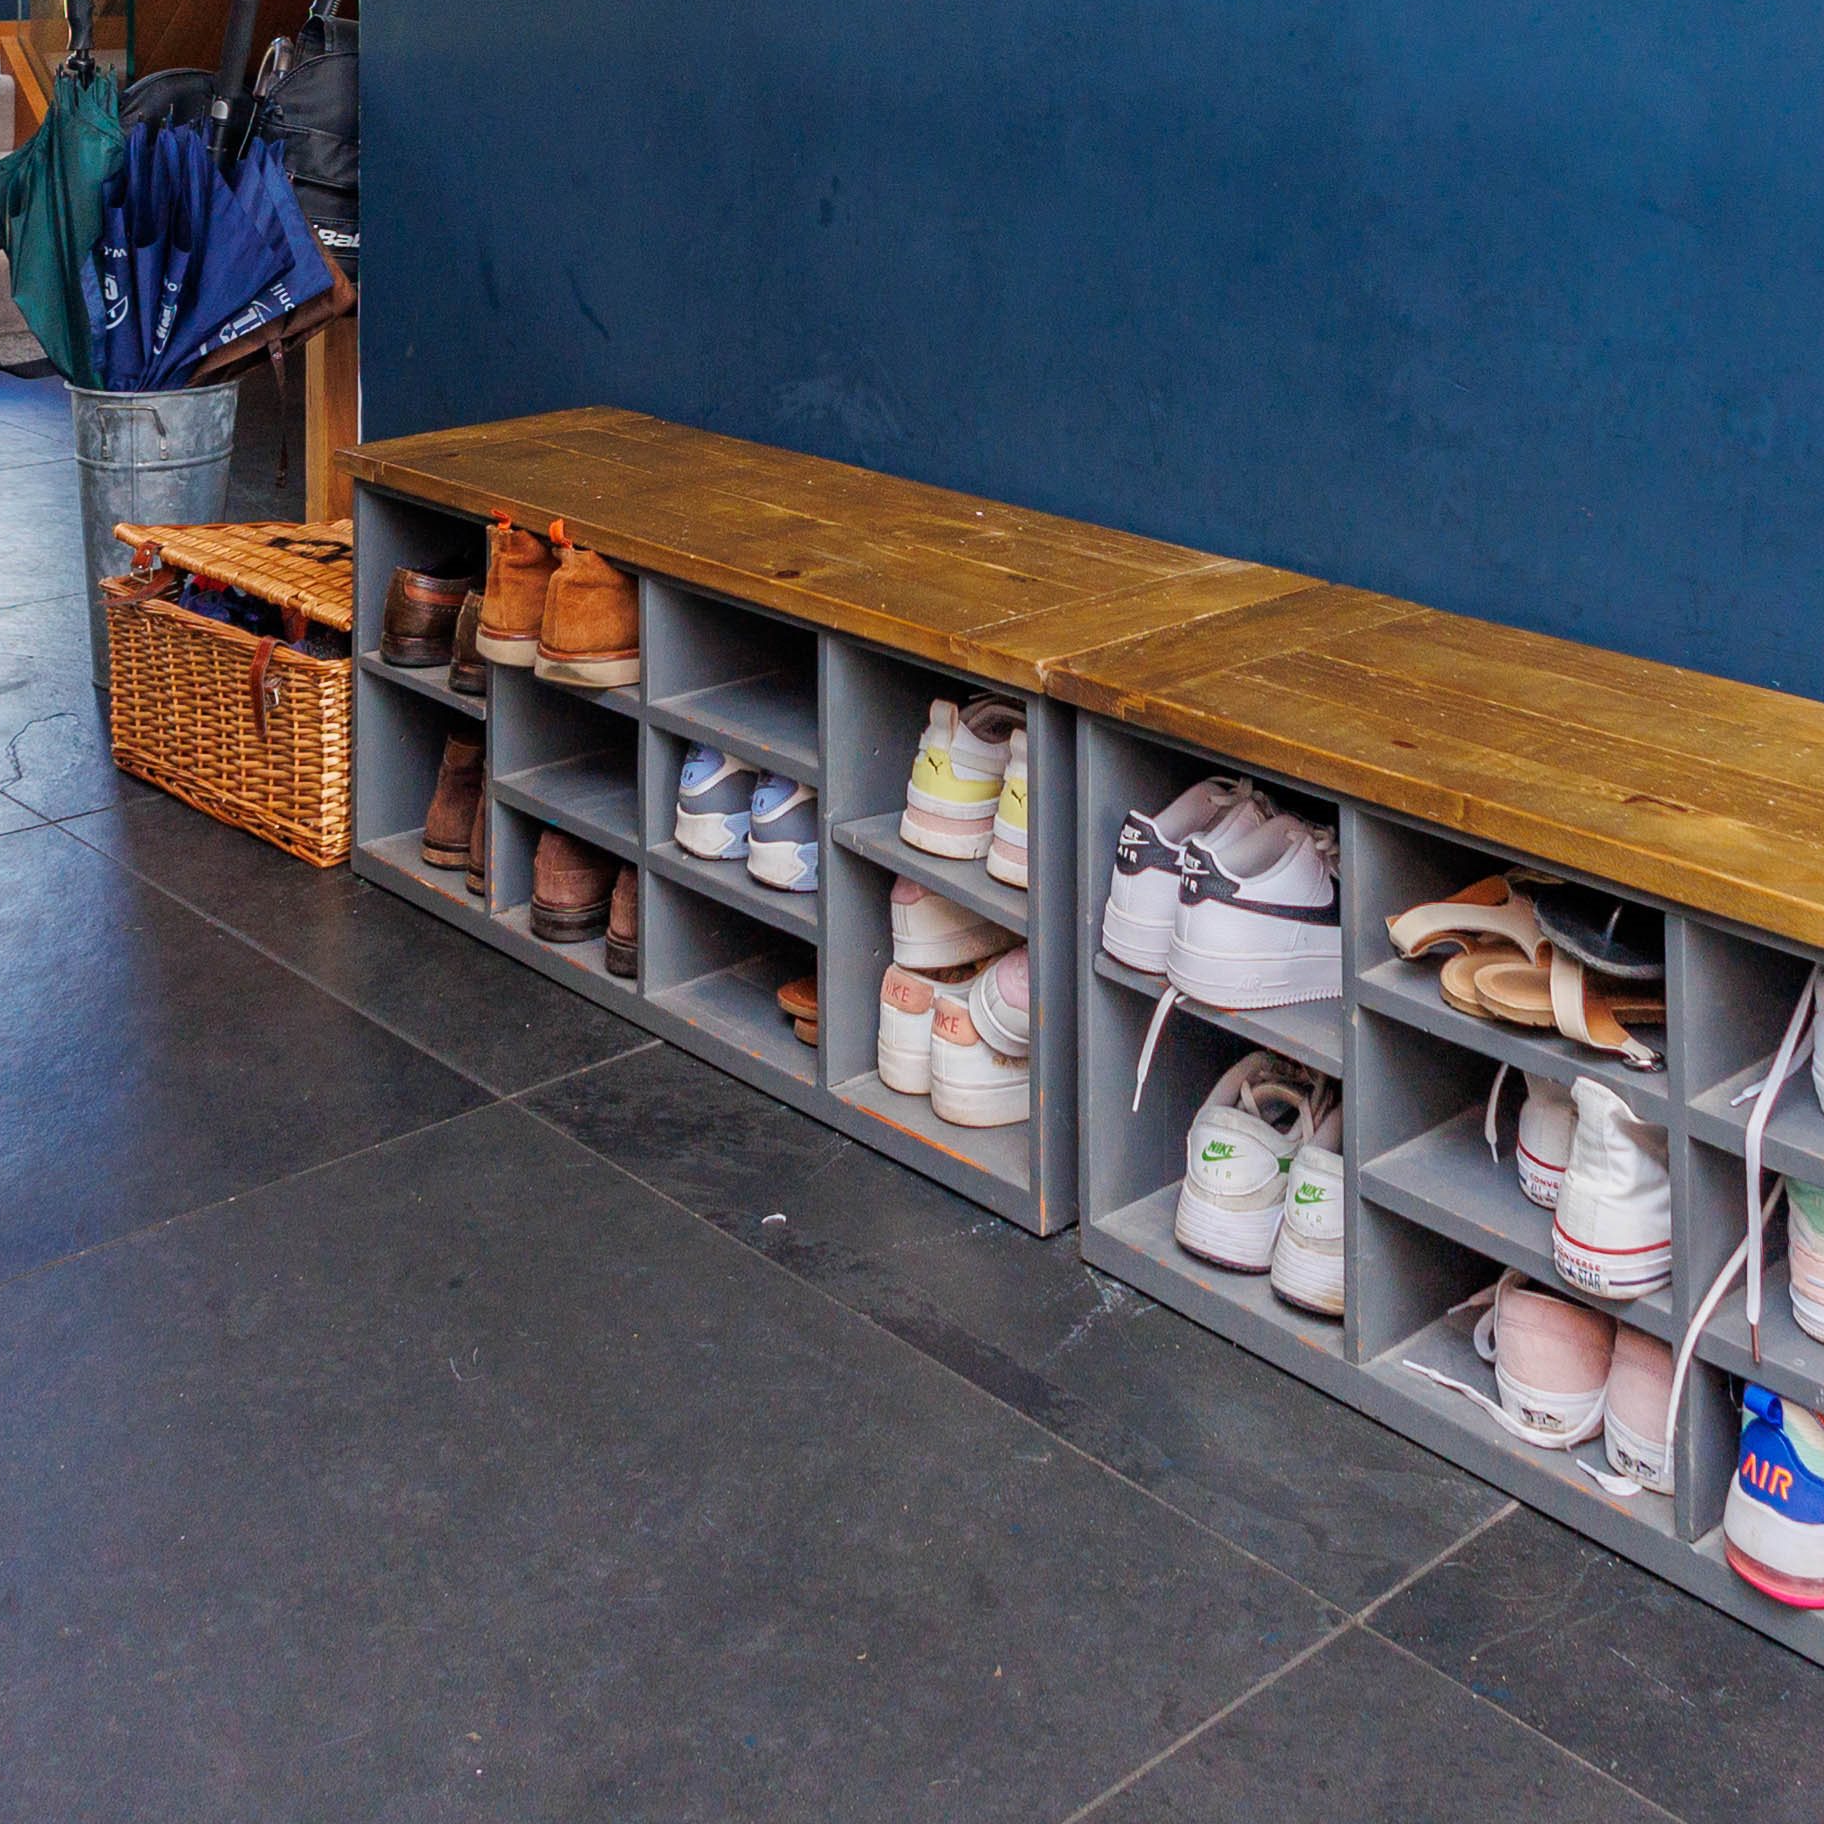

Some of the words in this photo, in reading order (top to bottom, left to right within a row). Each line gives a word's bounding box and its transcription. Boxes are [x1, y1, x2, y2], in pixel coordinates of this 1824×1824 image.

[1117, 844, 1137, 864] AIR
[1207, 1139, 1237, 1158] NIKE
[1299, 1181, 1327, 1200] NIKE
[1529, 1172, 1561, 1190] CONVE
[1578, 1267, 1601, 1291] STAR
[1741, 1451, 1794, 1502] AIR
